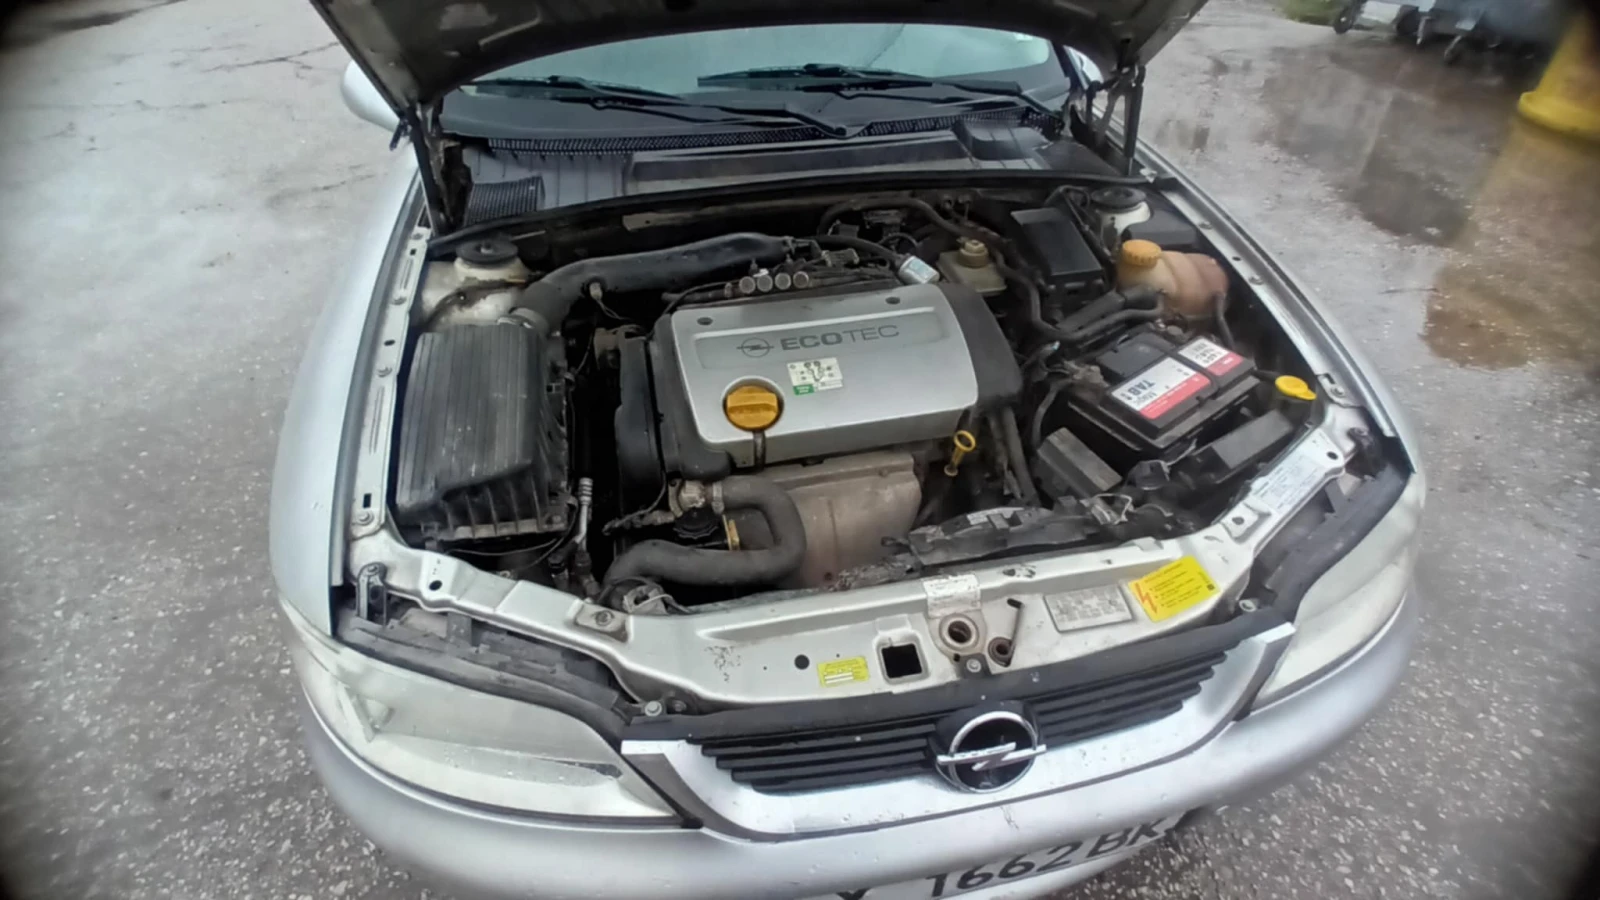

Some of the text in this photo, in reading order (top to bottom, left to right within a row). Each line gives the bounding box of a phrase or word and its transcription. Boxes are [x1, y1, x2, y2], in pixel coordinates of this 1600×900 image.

[780, 325, 900, 351] ECOTEC
[1127, 379, 1156, 397] TAB
[925, 841, 1083, 898] 1662
